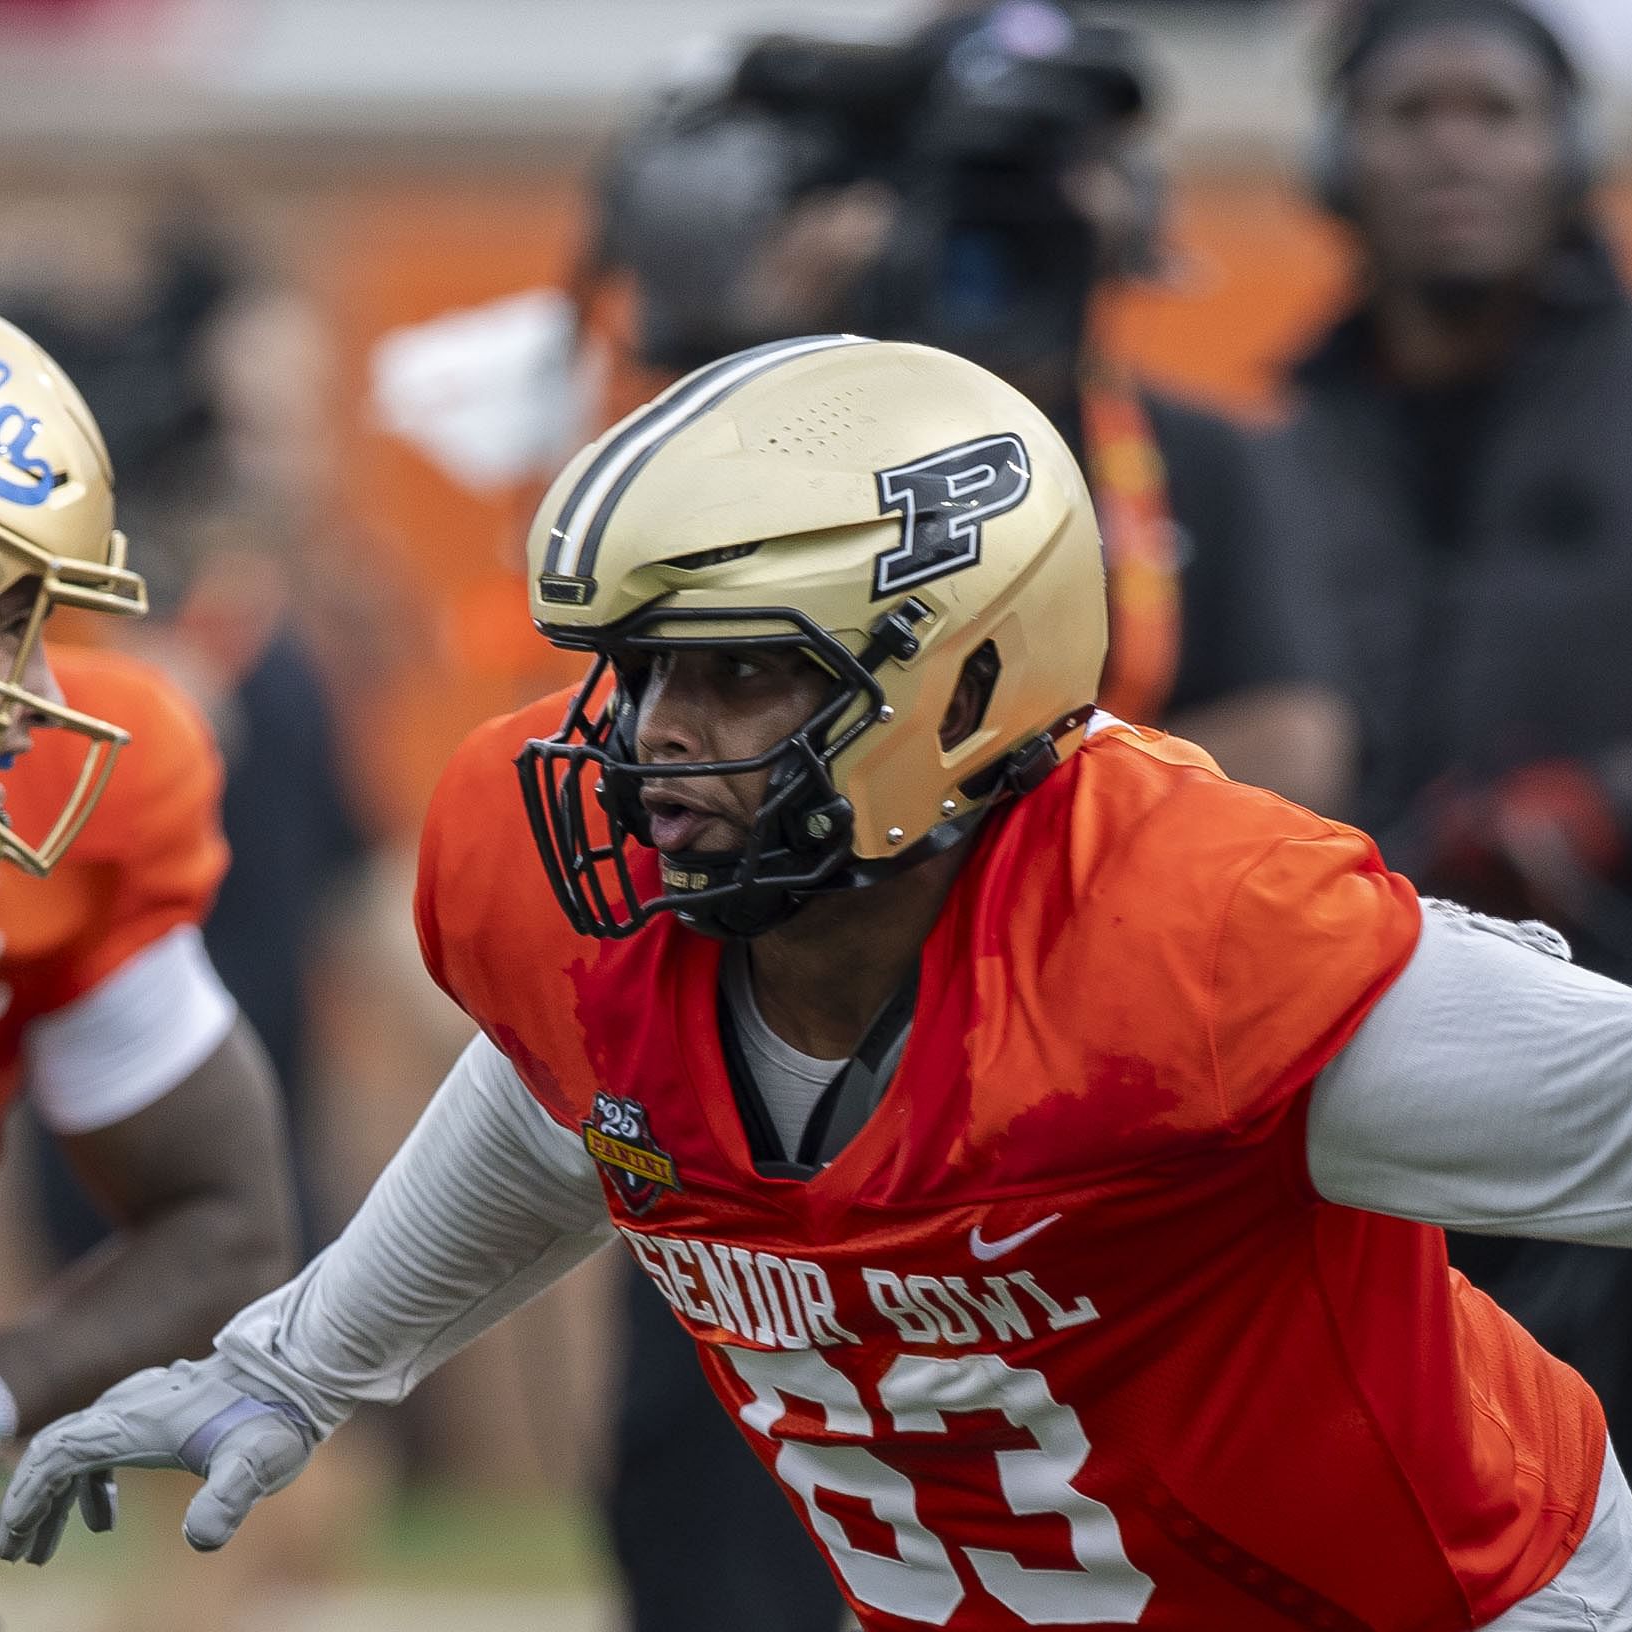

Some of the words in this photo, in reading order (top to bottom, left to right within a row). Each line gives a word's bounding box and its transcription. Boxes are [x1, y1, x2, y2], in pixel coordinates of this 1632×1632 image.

[873, 431, 1032, 603] P
[618, 1224, 862, 1351] SENIOR
[862, 1266, 1101, 1345] BOWL
